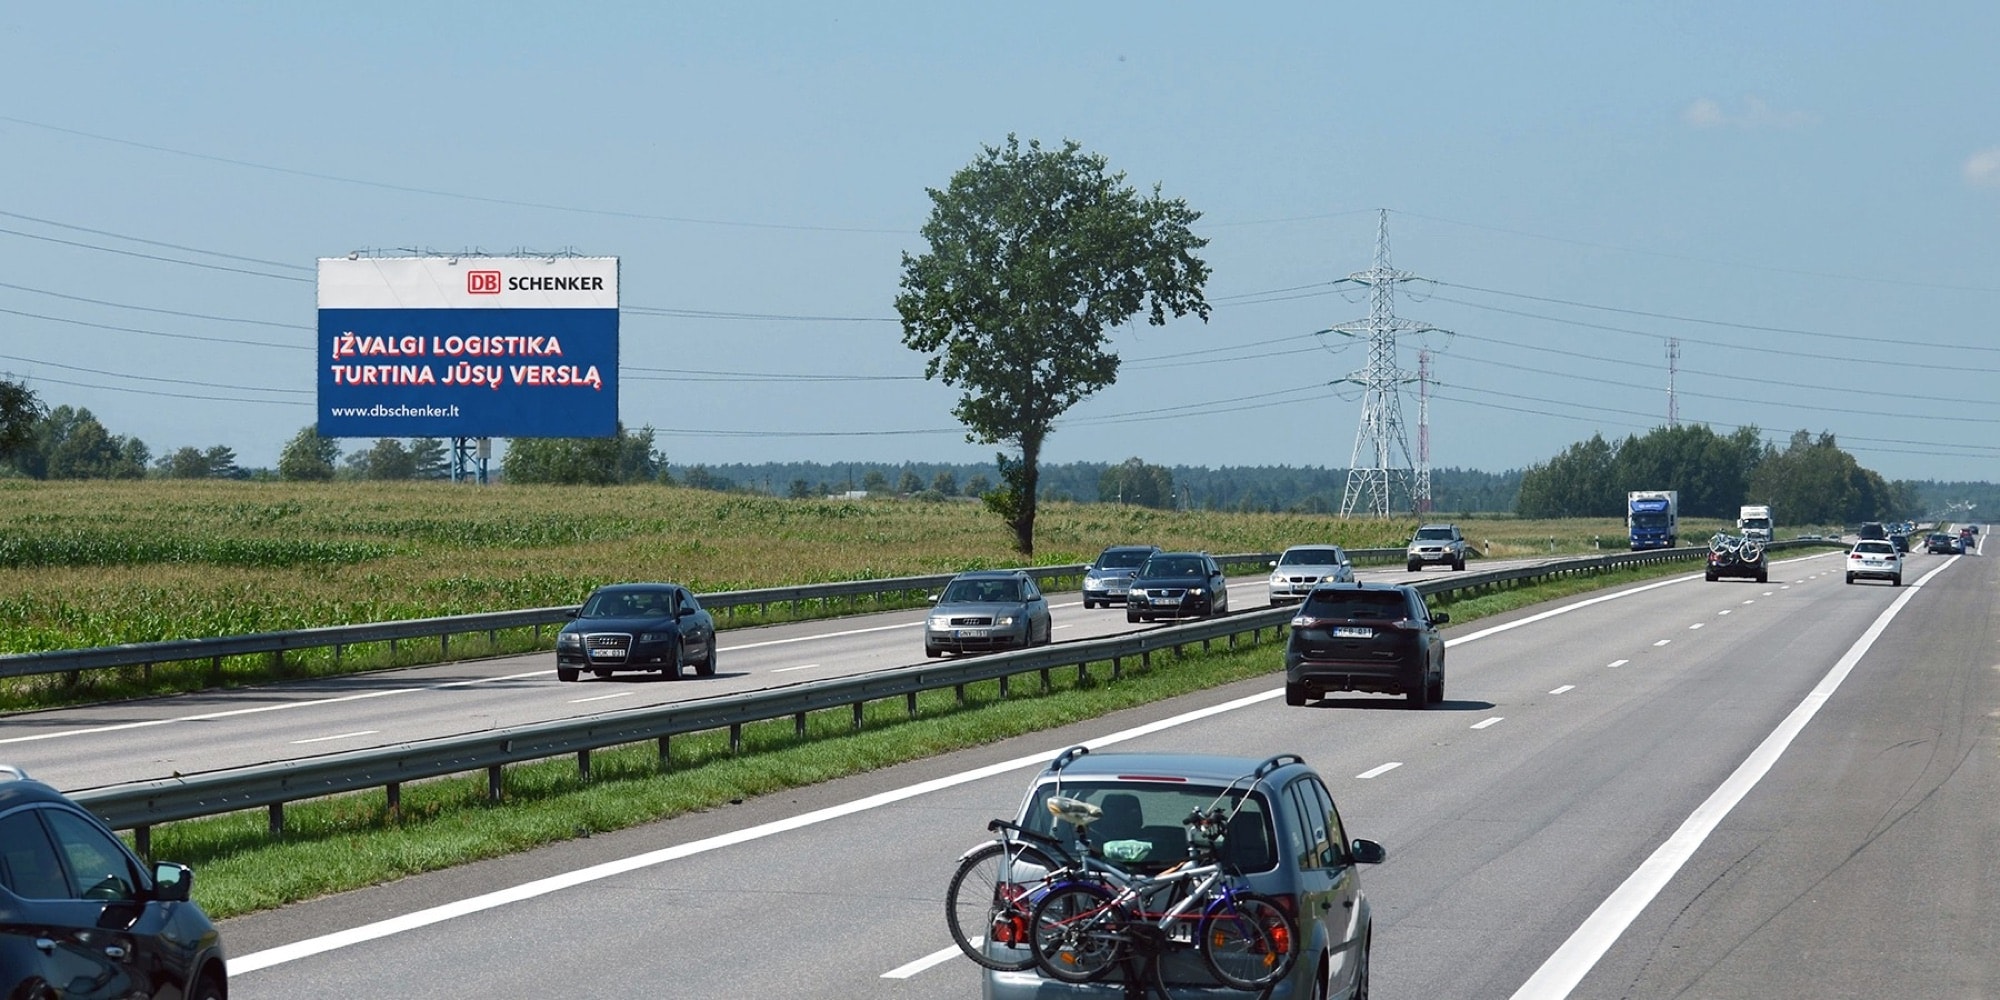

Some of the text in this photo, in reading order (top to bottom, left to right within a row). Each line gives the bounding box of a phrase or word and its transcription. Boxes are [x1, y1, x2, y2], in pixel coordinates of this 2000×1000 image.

[471, 274, 604, 291] DB SCHENKER
[331, 331, 563, 360] ĮŽVALGI LOGISTIKA
[331, 361, 603, 391] TURTINA JŪSŲ VERSLĄ
[331, 404, 460, 418] www.dbschenker.lt
